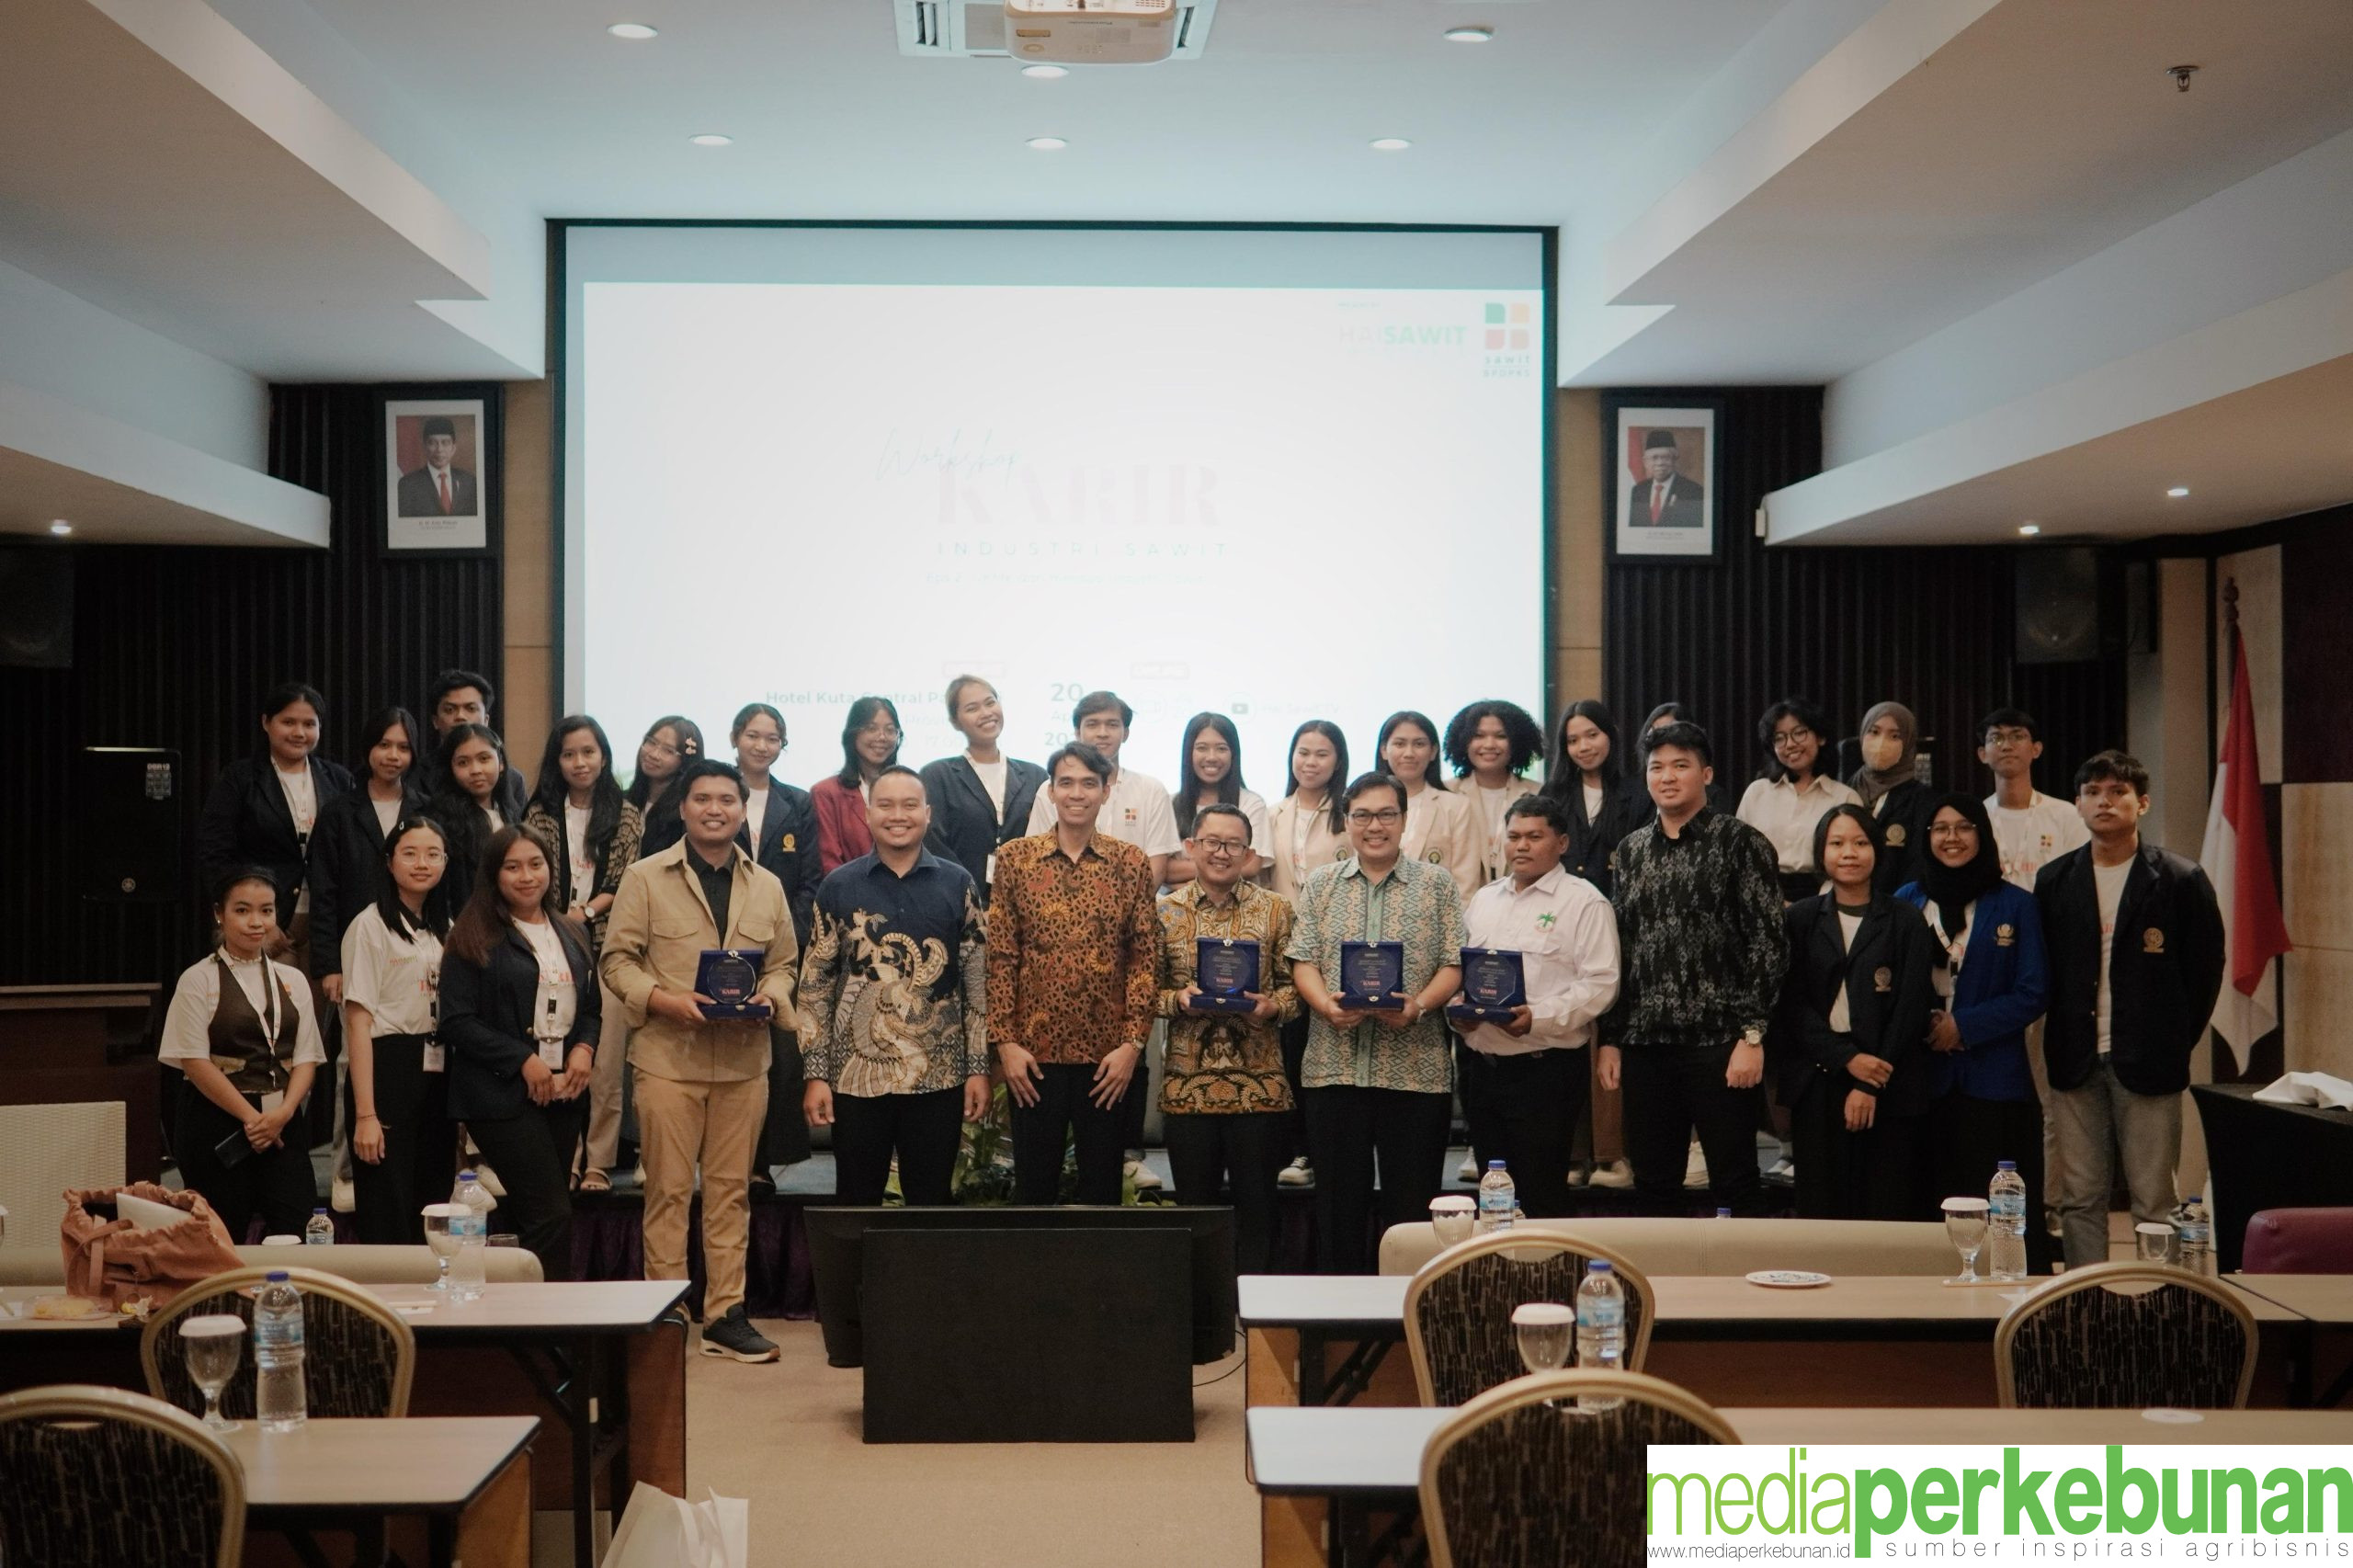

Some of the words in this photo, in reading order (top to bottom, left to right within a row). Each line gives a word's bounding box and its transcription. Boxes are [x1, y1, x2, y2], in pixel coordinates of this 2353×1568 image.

[938, 540, 1101, 556] INDUSTRI
[1125, 540, 1228, 557] SAWIT
[766, 691, 812, 704] Hotel
[816, 691, 855, 704] Kuta
[1051, 683, 1084, 701] 20
